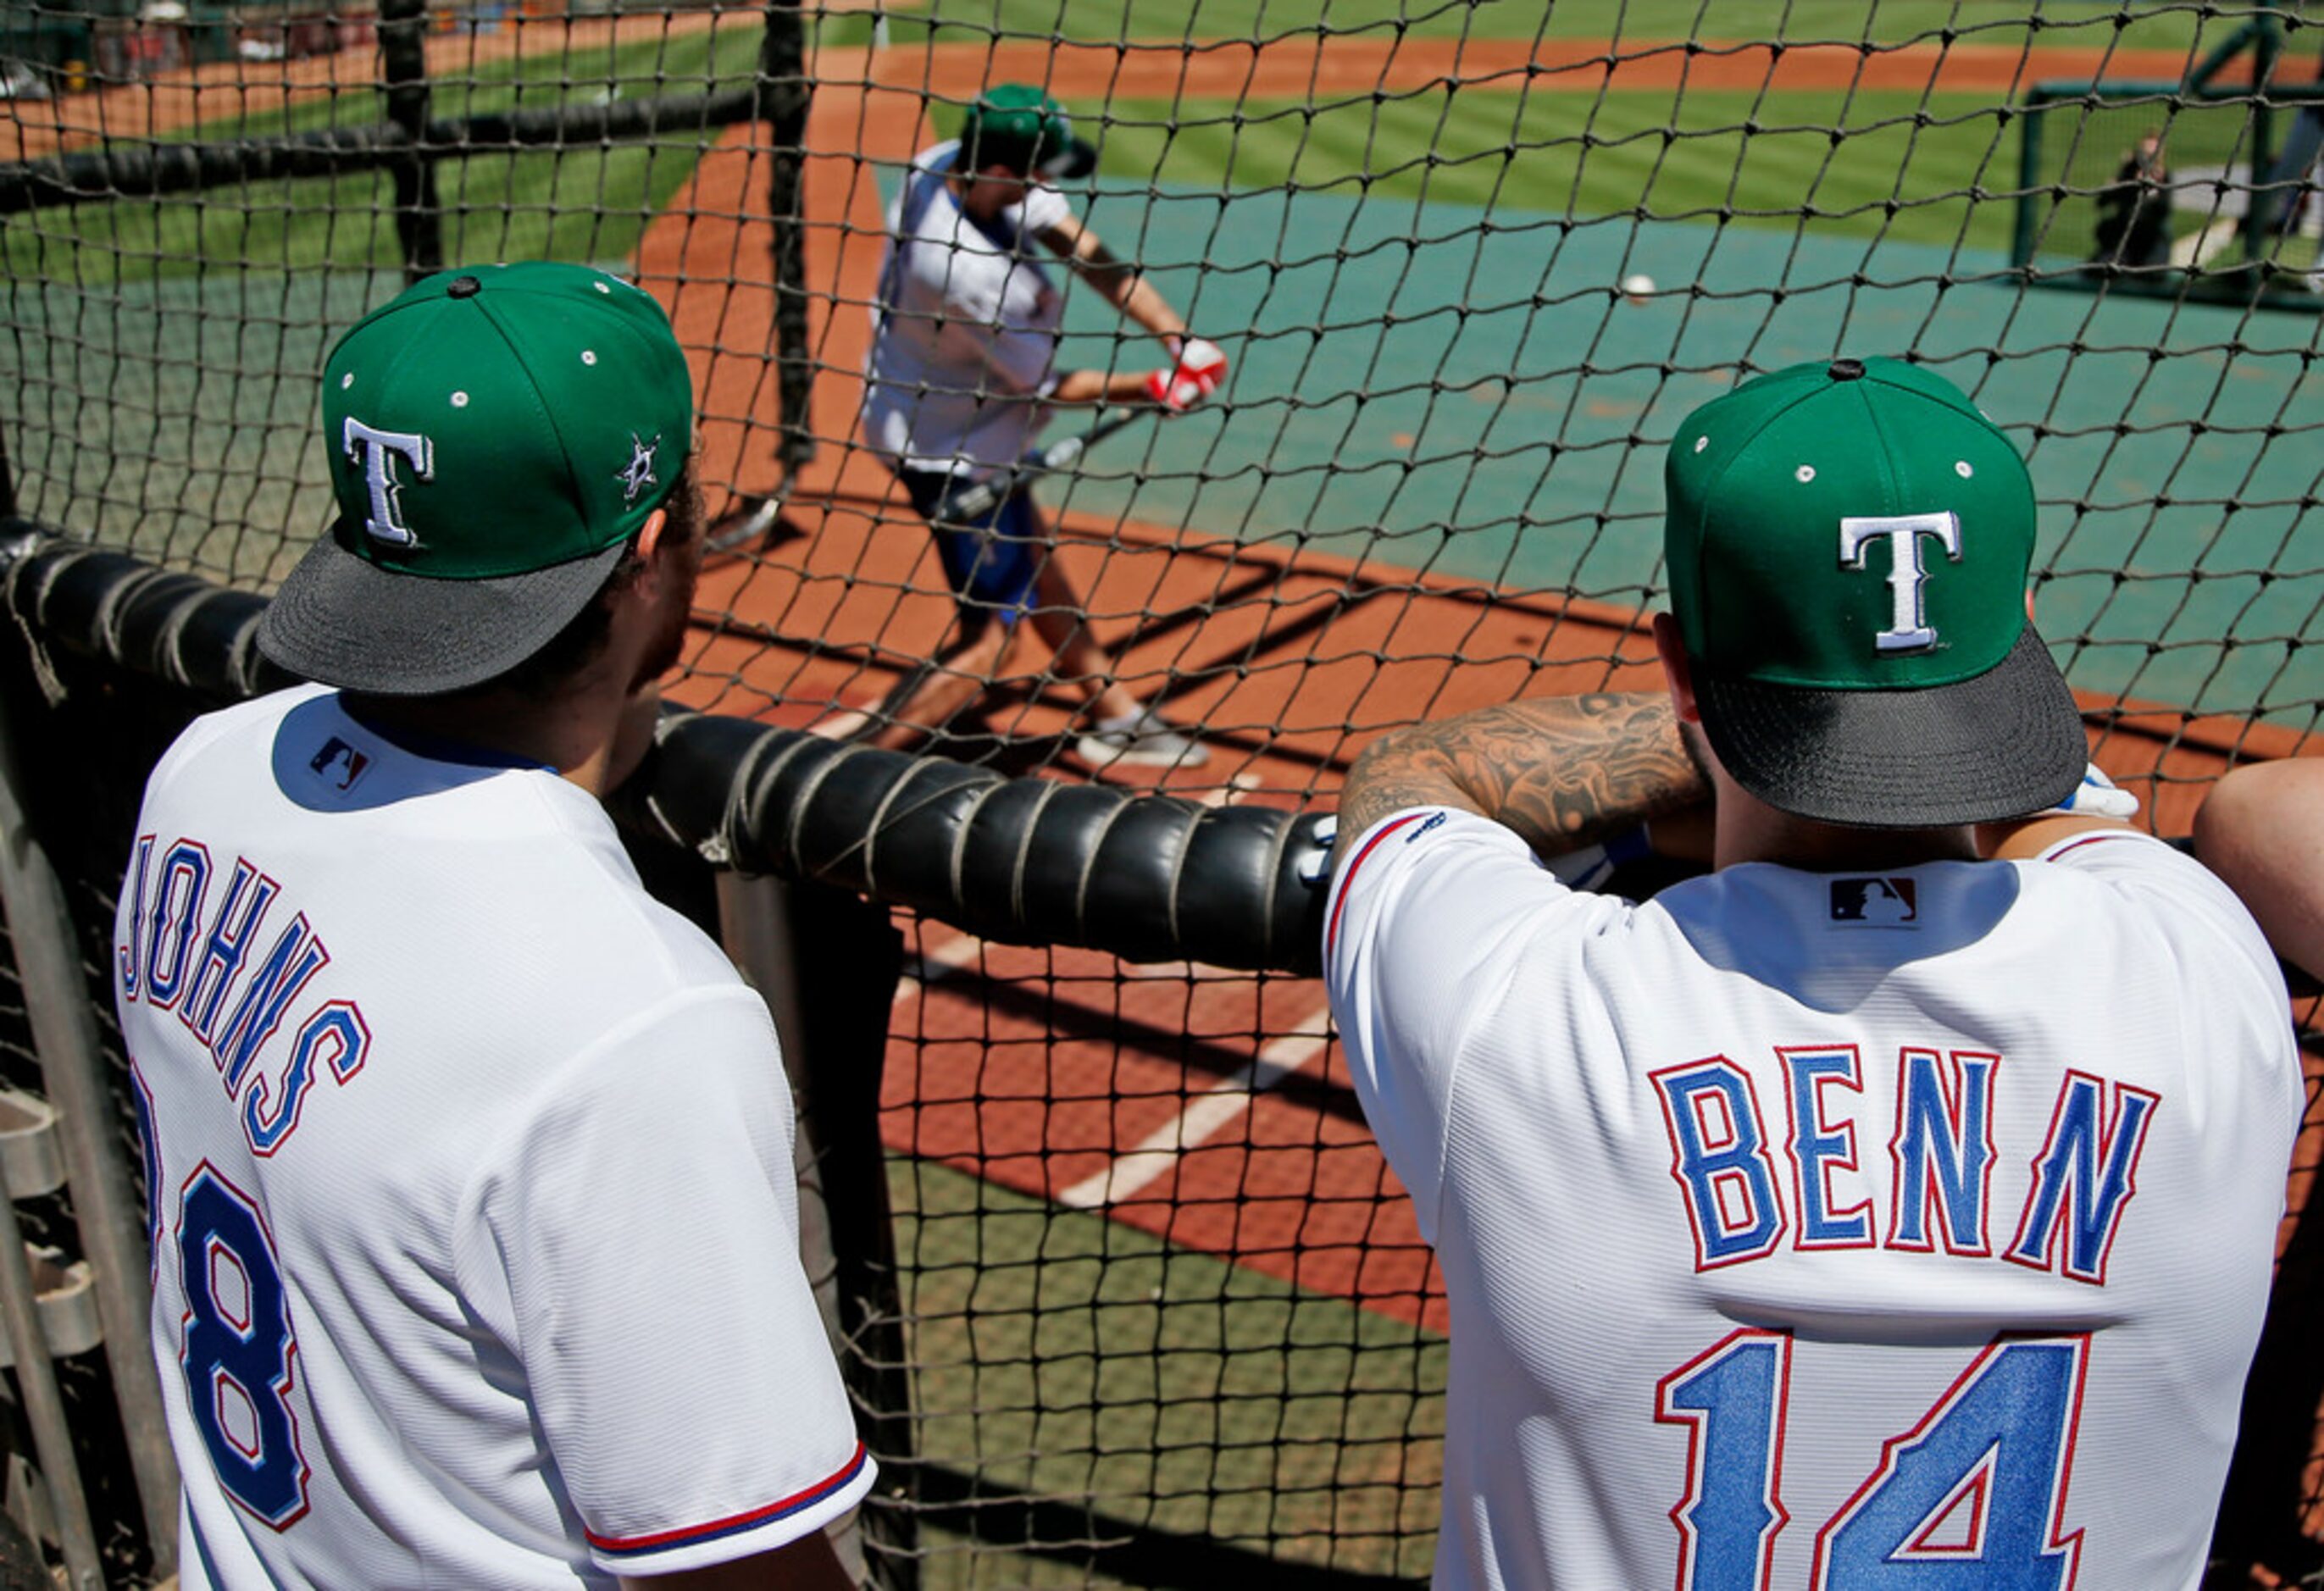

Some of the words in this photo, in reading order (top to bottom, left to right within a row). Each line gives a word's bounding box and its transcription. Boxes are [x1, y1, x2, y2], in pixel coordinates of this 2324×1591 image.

[344, 415, 435, 547] T
[1839, 510, 1961, 655] T
[119, 834, 372, 1158] JOHNS
[1648, 1043, 2162, 1287] BENN
[1655, 1327, 2092, 1591] 14
